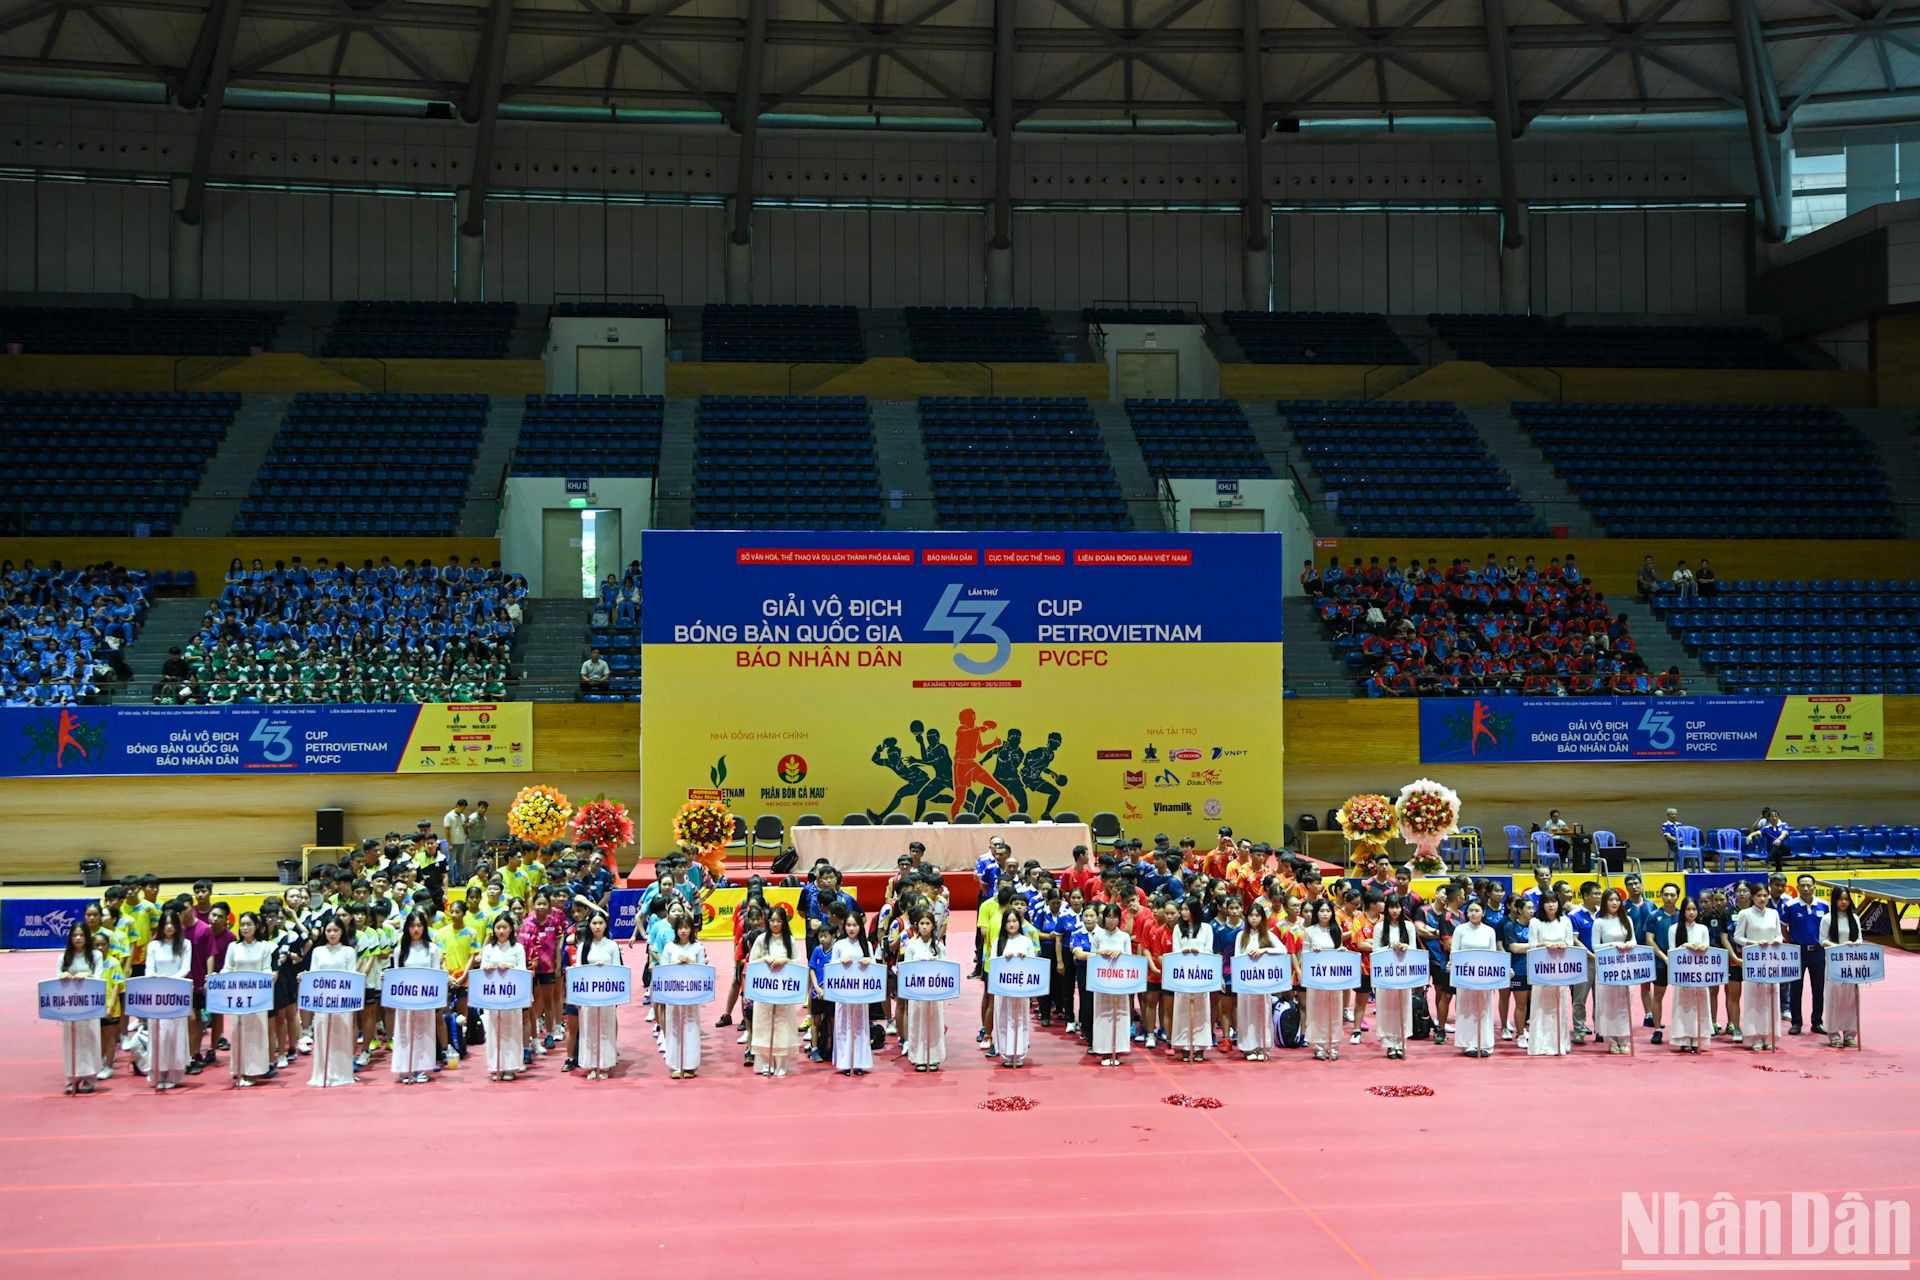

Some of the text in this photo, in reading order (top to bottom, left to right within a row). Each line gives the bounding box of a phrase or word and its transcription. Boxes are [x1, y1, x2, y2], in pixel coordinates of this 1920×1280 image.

[927, 552, 972, 561] BÁO NHÂN DÂN
[762, 592, 902, 621] GIẢI VÔ ĐỊCH
[1038, 599, 1082, 617] CUP
[674, 616, 902, 643] BÓNG BÀN QUỐC GIA
[923, 583, 1011, 675] 43
[1038, 624, 1202, 642] PETROVIETNAM
[736, 645, 902, 667] BÁO NHÂN DÂN
[1038, 650, 1108, 666] PVCFC
[1568, 719, 1628, 732] GIẢI VÔ ĐỊCH
[1637, 708, 1675, 750] 43
[1686, 722, 1706, 730] CUP
[170, 730, 239, 744] GIẢI VÔ ĐỊCH
[249, 718, 292, 762] 43
[305, 731, 328, 740] CUP
[1532, 730, 1628, 742] BÓNG BÀN QUỐC GIA
[1686, 732, 1758, 740] PETROVIETNAM
[126, 740, 239, 754] BÓNG BÀN QUỐC GIA
[305, 743, 388, 752] PETROVIETNAM
[1558, 742, 1629, 752] BÁO NHÂN DÂN
[1686, 743, 1718, 752] PVCFC
[156, 754, 239, 766] BÁO NHÂN DÂN
[305, 754, 341, 764] PVCFC
[761, 786, 824, 798] PHÂN BÓN CÀ MAU
[1153, 802, 1192, 812] Vinamilk
[1677, 954, 1722, 966] CÂU LẠC BỘ
[1831, 951, 1880, 962] CLB TRÀNG AN
[1096, 966, 1139, 982] TRỌNG TÀI
[1172, 964, 1213, 980] ĐÀ NẴNG
[1240, 966, 1284, 983] QUÂN ĐỘI
[1310, 964, 1352, 977] TÂY NINH
[1455, 962, 1506, 978] TIẾN GIANG
[1534, 962, 1582, 974] VĨNH LONG
[1604, 967, 1650, 982] PPP CÀ MAU
[1841, 965, 1870, 980] HÀ NỘI
[313, 978, 352, 990] CÔNG AN
[572, 977, 625, 992] HẢI PHÒNG
[752, 976, 800, 992] HƯNG YÊN
[828, 974, 882, 990] KHÁNH HÒA
[905, 972, 954, 988] LÂM ĐỒNG
[1000, 970, 1040, 988] NGHỆ AN
[1674, 972, 1724, 983] TIMES CITY
[390, 980, 438, 997] ĐỒNG NAI
[483, 982, 516, 999] HÀ NỘI
[128, 992, 190, 1006] BÌNH DƯƠNG
[227, 996, 252, 1008] T & T
